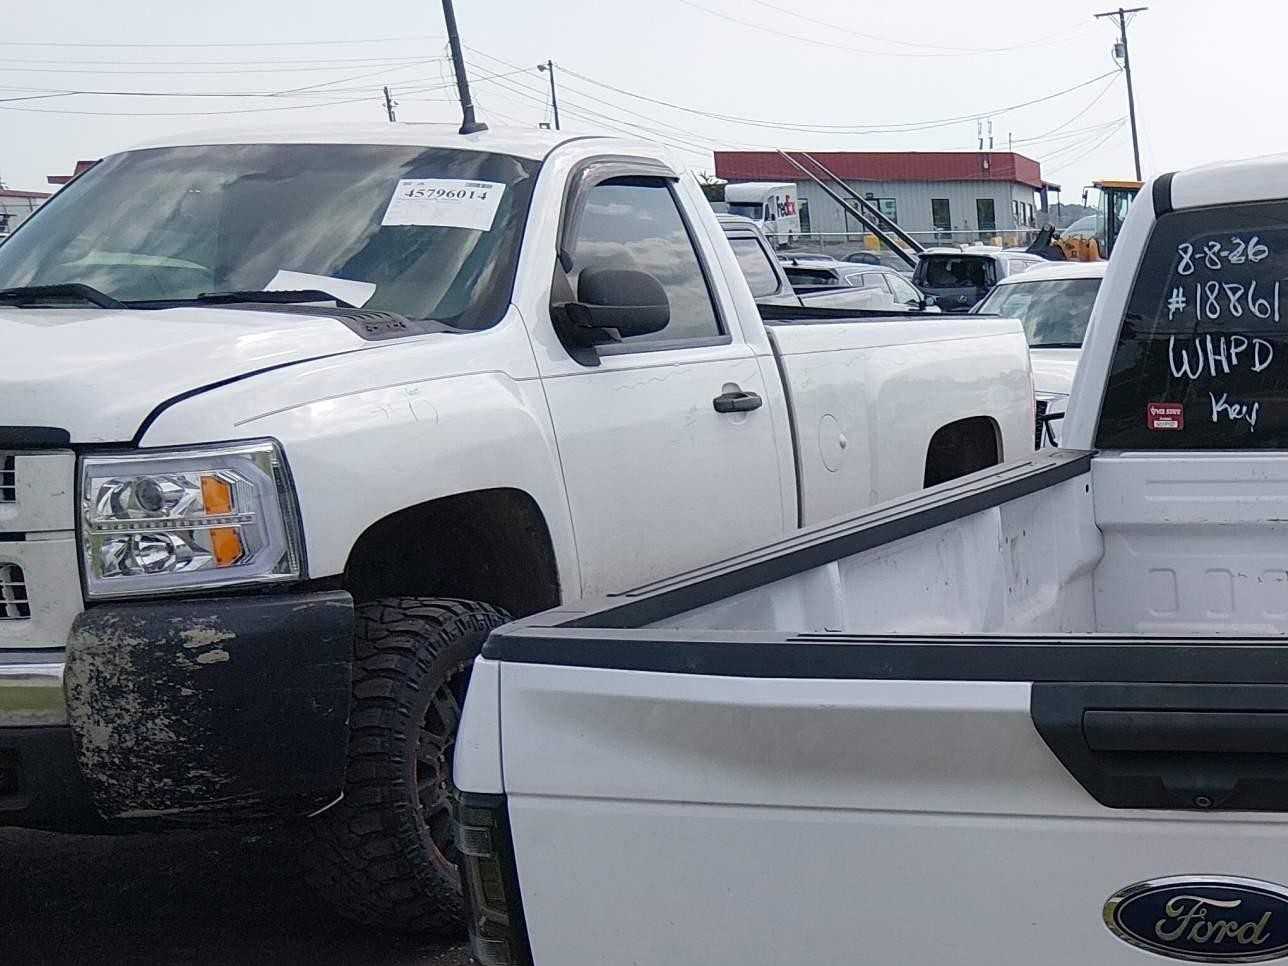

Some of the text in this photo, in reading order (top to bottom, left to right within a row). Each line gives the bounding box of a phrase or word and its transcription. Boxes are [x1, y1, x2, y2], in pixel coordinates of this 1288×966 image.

[404, 188, 488, 201] 45796014
[1177, 236, 1269, 275] 8-8-26
[1167, 280, 1281, 322] #18861
[1168, 334, 1274, 380] WHPD
[1209, 392, 1259, 433] Key
[1154, 894, 1272, 945] Ford
